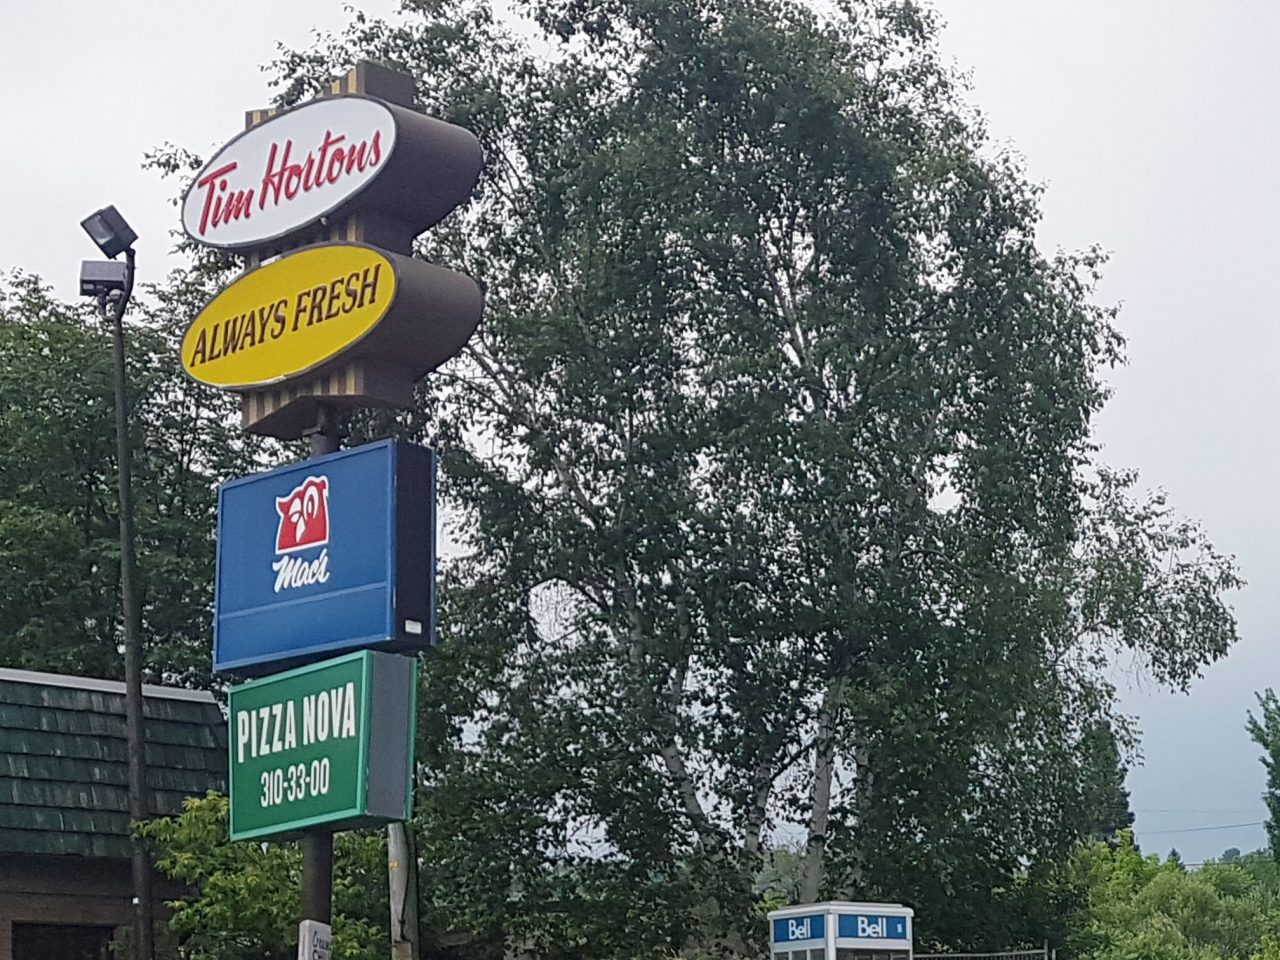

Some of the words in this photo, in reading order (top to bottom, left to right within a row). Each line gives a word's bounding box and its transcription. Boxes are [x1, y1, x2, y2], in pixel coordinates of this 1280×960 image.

[197, 161, 255, 236] Tim
[259, 129, 382, 211] Hortons
[189, 298, 288, 368] ALWAYS
[291, 262, 383, 333] FRESH
[271, 547, 331, 593] Mac's
[237, 699, 298, 764] PIZZA
[302, 681, 356, 746] NOVA
[260, 756, 331, 808] 310-33-00
[788, 918, 811, 940] Bell
[857, 915, 887, 938] Bell
